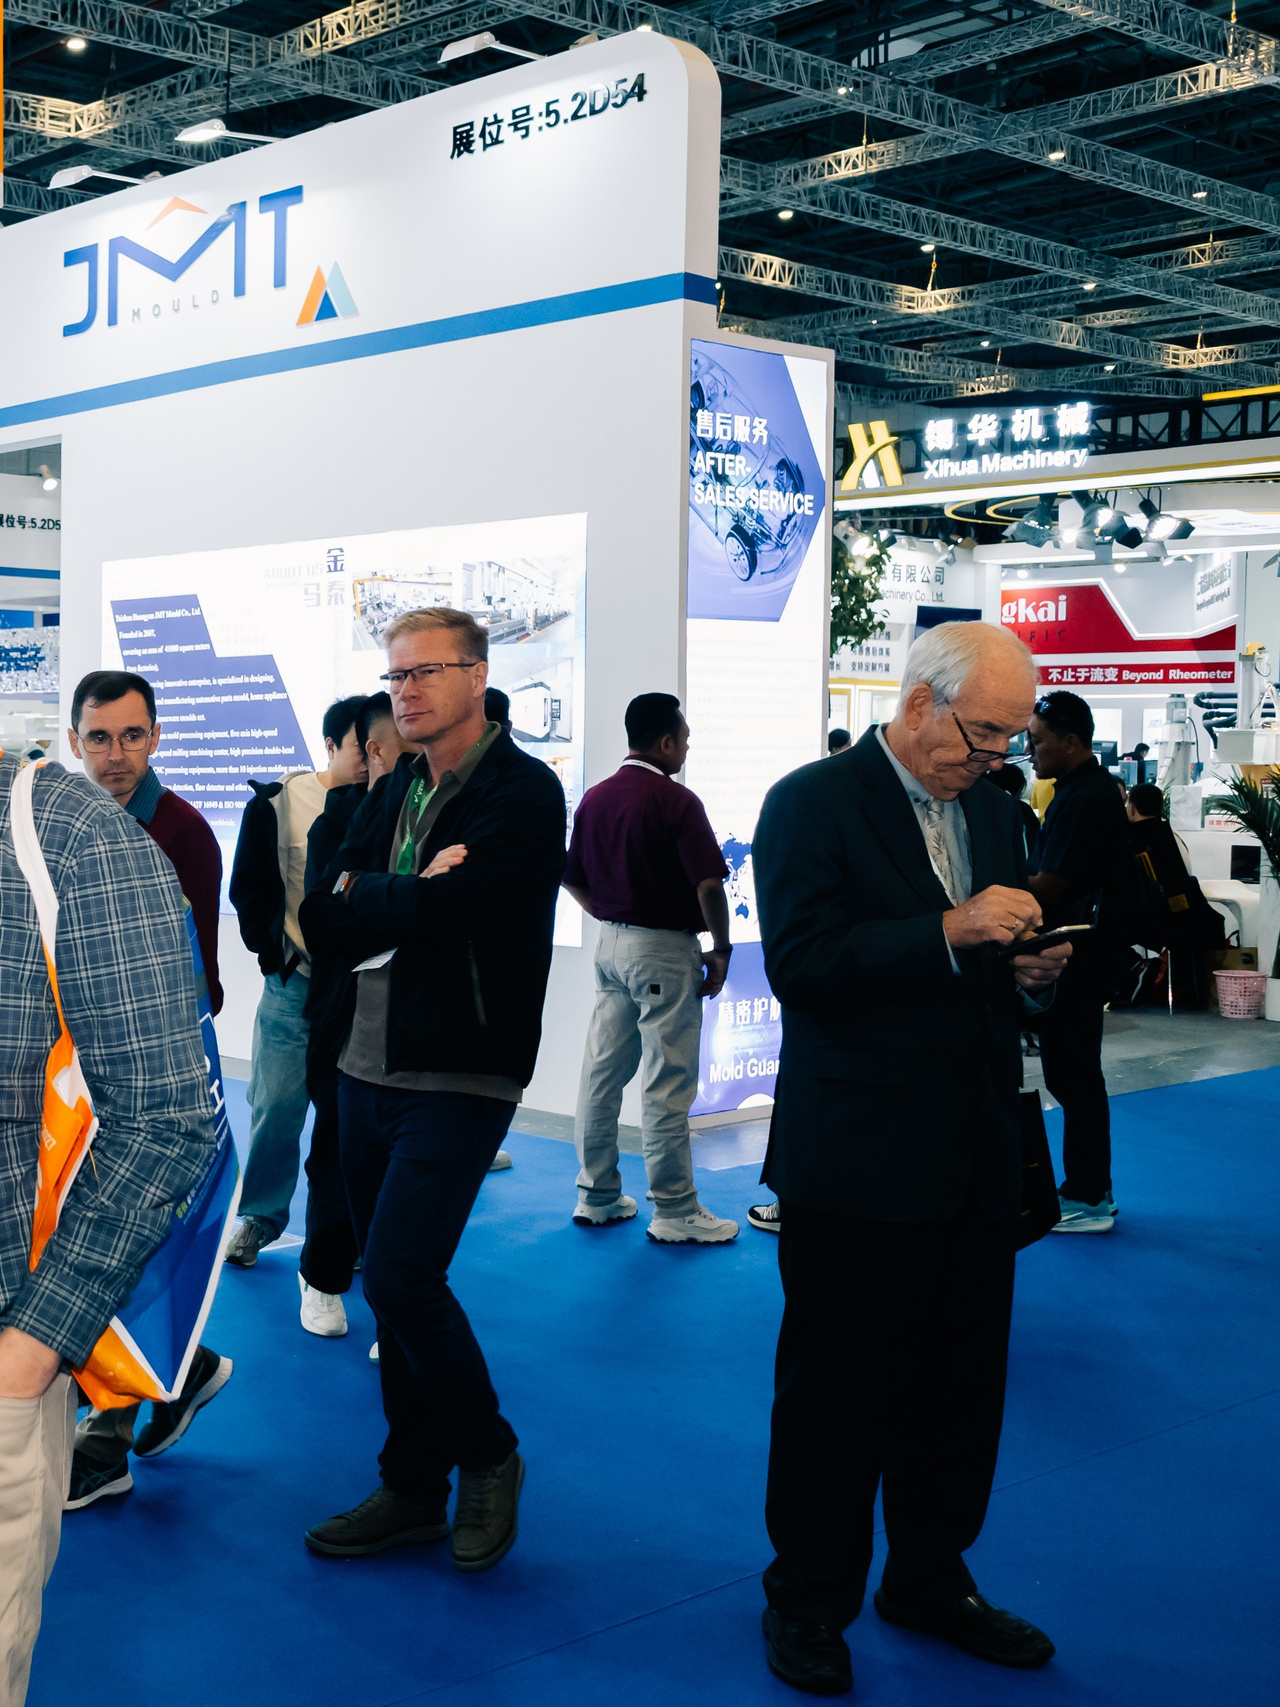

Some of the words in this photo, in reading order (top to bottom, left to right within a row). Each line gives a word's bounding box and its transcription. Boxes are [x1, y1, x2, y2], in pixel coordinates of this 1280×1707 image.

[450, 72, 648, 160] 展位号:5.2D54
[63, 184, 303, 338] JMT
[131, 289, 220, 322] MOULD
[696, 409, 768, 445] 售后服务
[694, 450, 751, 477] AFTER-
[924, 458, 979, 480] Xihua
[981, 448, 1089, 474] Machinery
[694, 482, 746, 508] SALES
[749, 488, 814, 516] SERVICE
[881, 588, 913, 603] achinery
[1048, 667, 1118, 682] 不止于流变
[1122, 669, 1164, 683] Beyond
[1169, 669, 1233, 680] Rheometer
[710, 1060, 743, 1084] Mold
